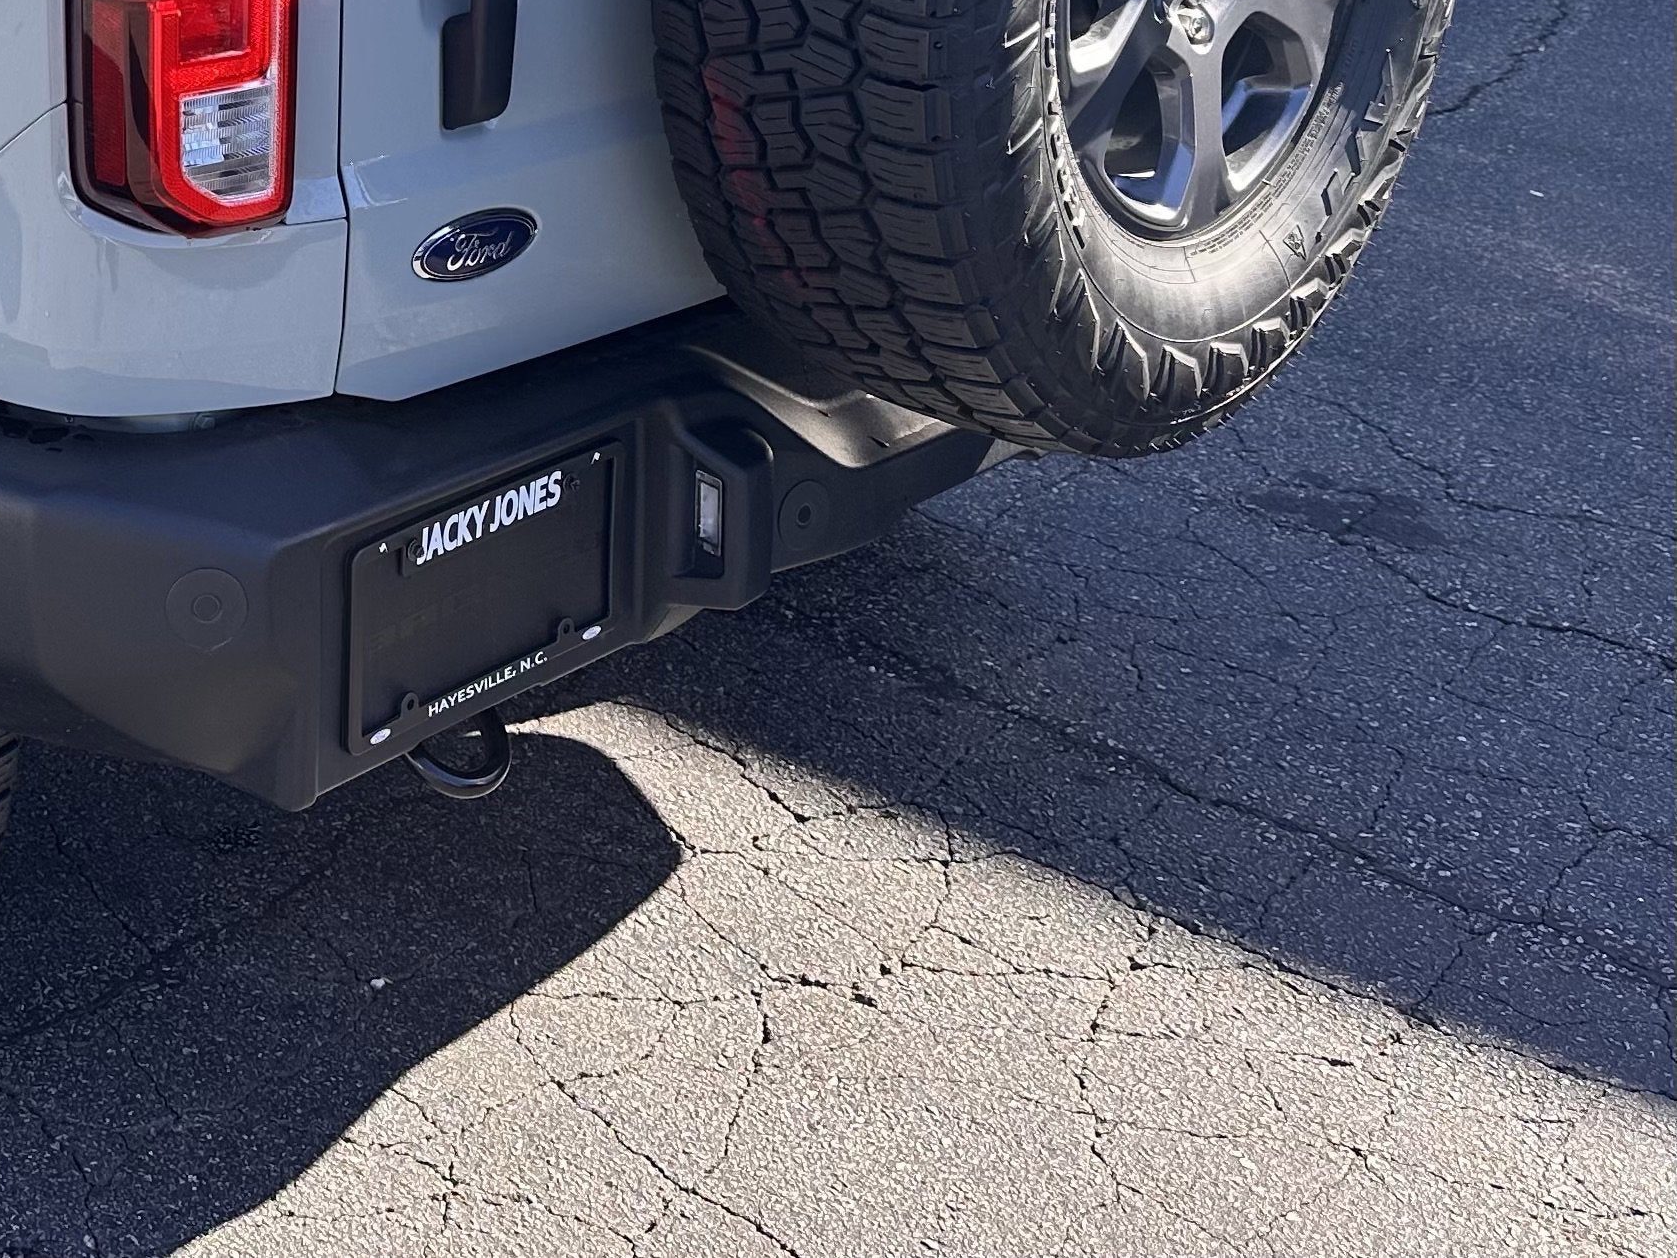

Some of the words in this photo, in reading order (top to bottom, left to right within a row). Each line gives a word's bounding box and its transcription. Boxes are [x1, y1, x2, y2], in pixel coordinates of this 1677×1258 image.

[446, 226, 515, 272] Ford
[416, 499, 490, 565] JACKY
[489, 470, 562, 532] JONES
[427, 666, 517, 717] HAYESVILLE,
[520, 650, 548, 673] N.C.
